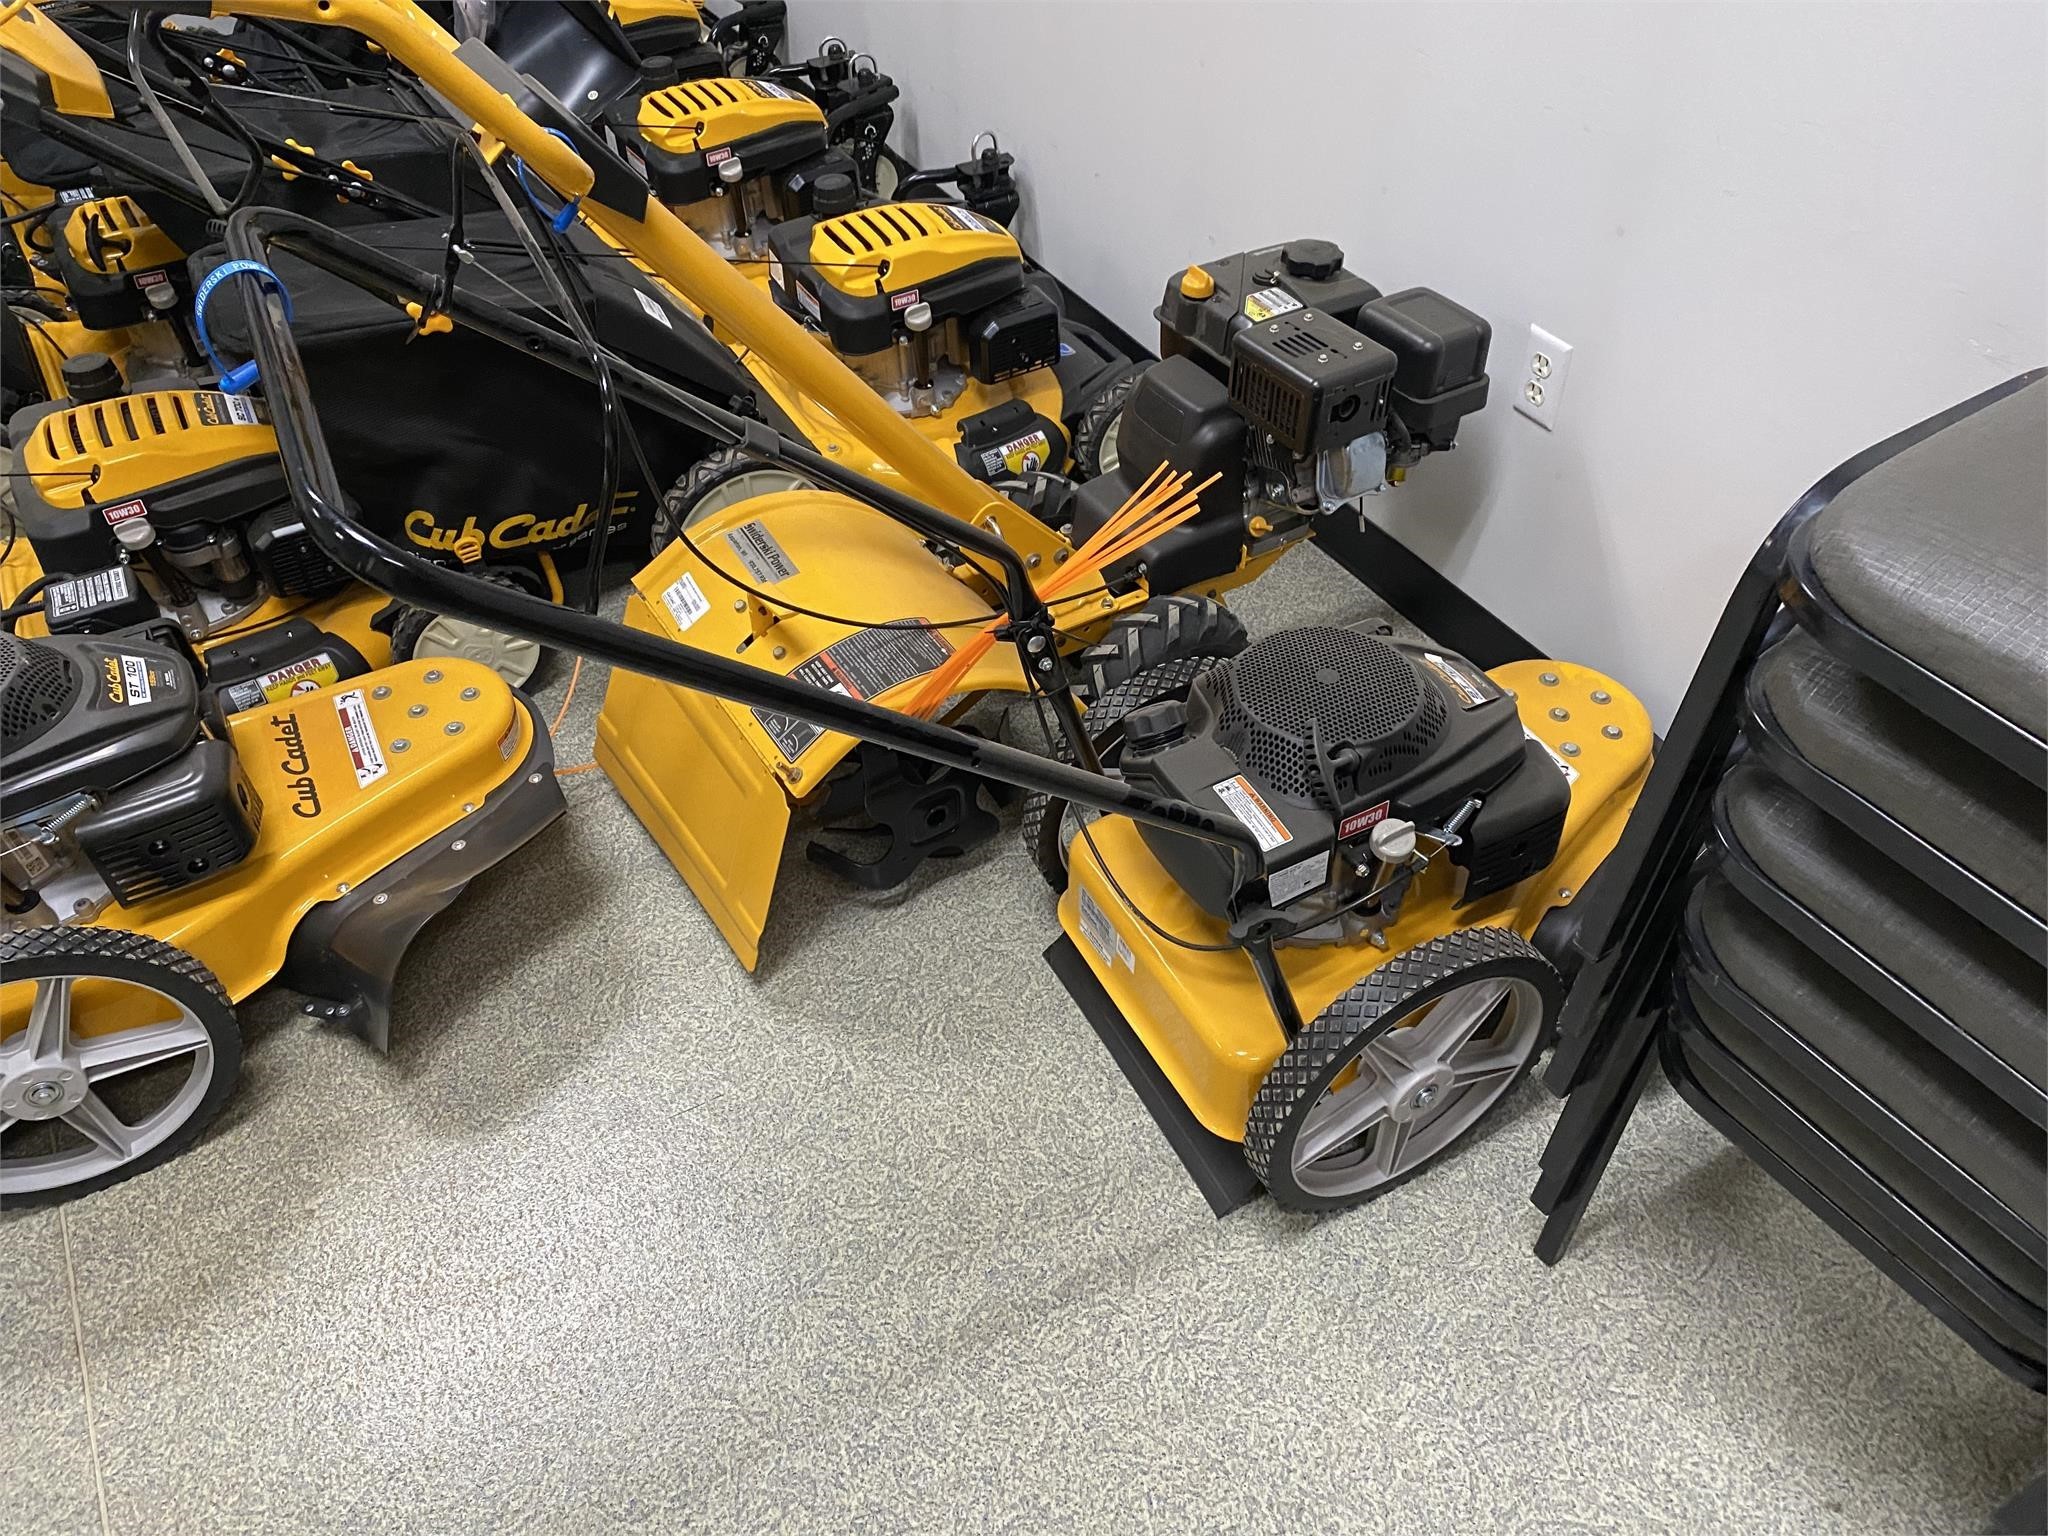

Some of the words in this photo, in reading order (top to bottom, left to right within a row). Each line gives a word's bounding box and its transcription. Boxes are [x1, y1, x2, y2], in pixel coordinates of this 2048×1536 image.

[1006, 434, 1041, 453] DANGER
[108, 504, 141, 520] 10W30
[404, 510, 486, 551] Cub
[744, 522, 776, 557] Swiderski
[767, 553, 790, 577] Power
[103, 657, 121, 683] Cadet
[125, 660, 137, 677] 100
[267, 658, 322, 684] DANGER
[108, 683, 124, 703] Cub
[129, 682, 140, 698] ST
[270, 713, 310, 775] Cadet
[287, 777, 321, 818] Cub
[1344, 809, 1383, 833] 10W30
